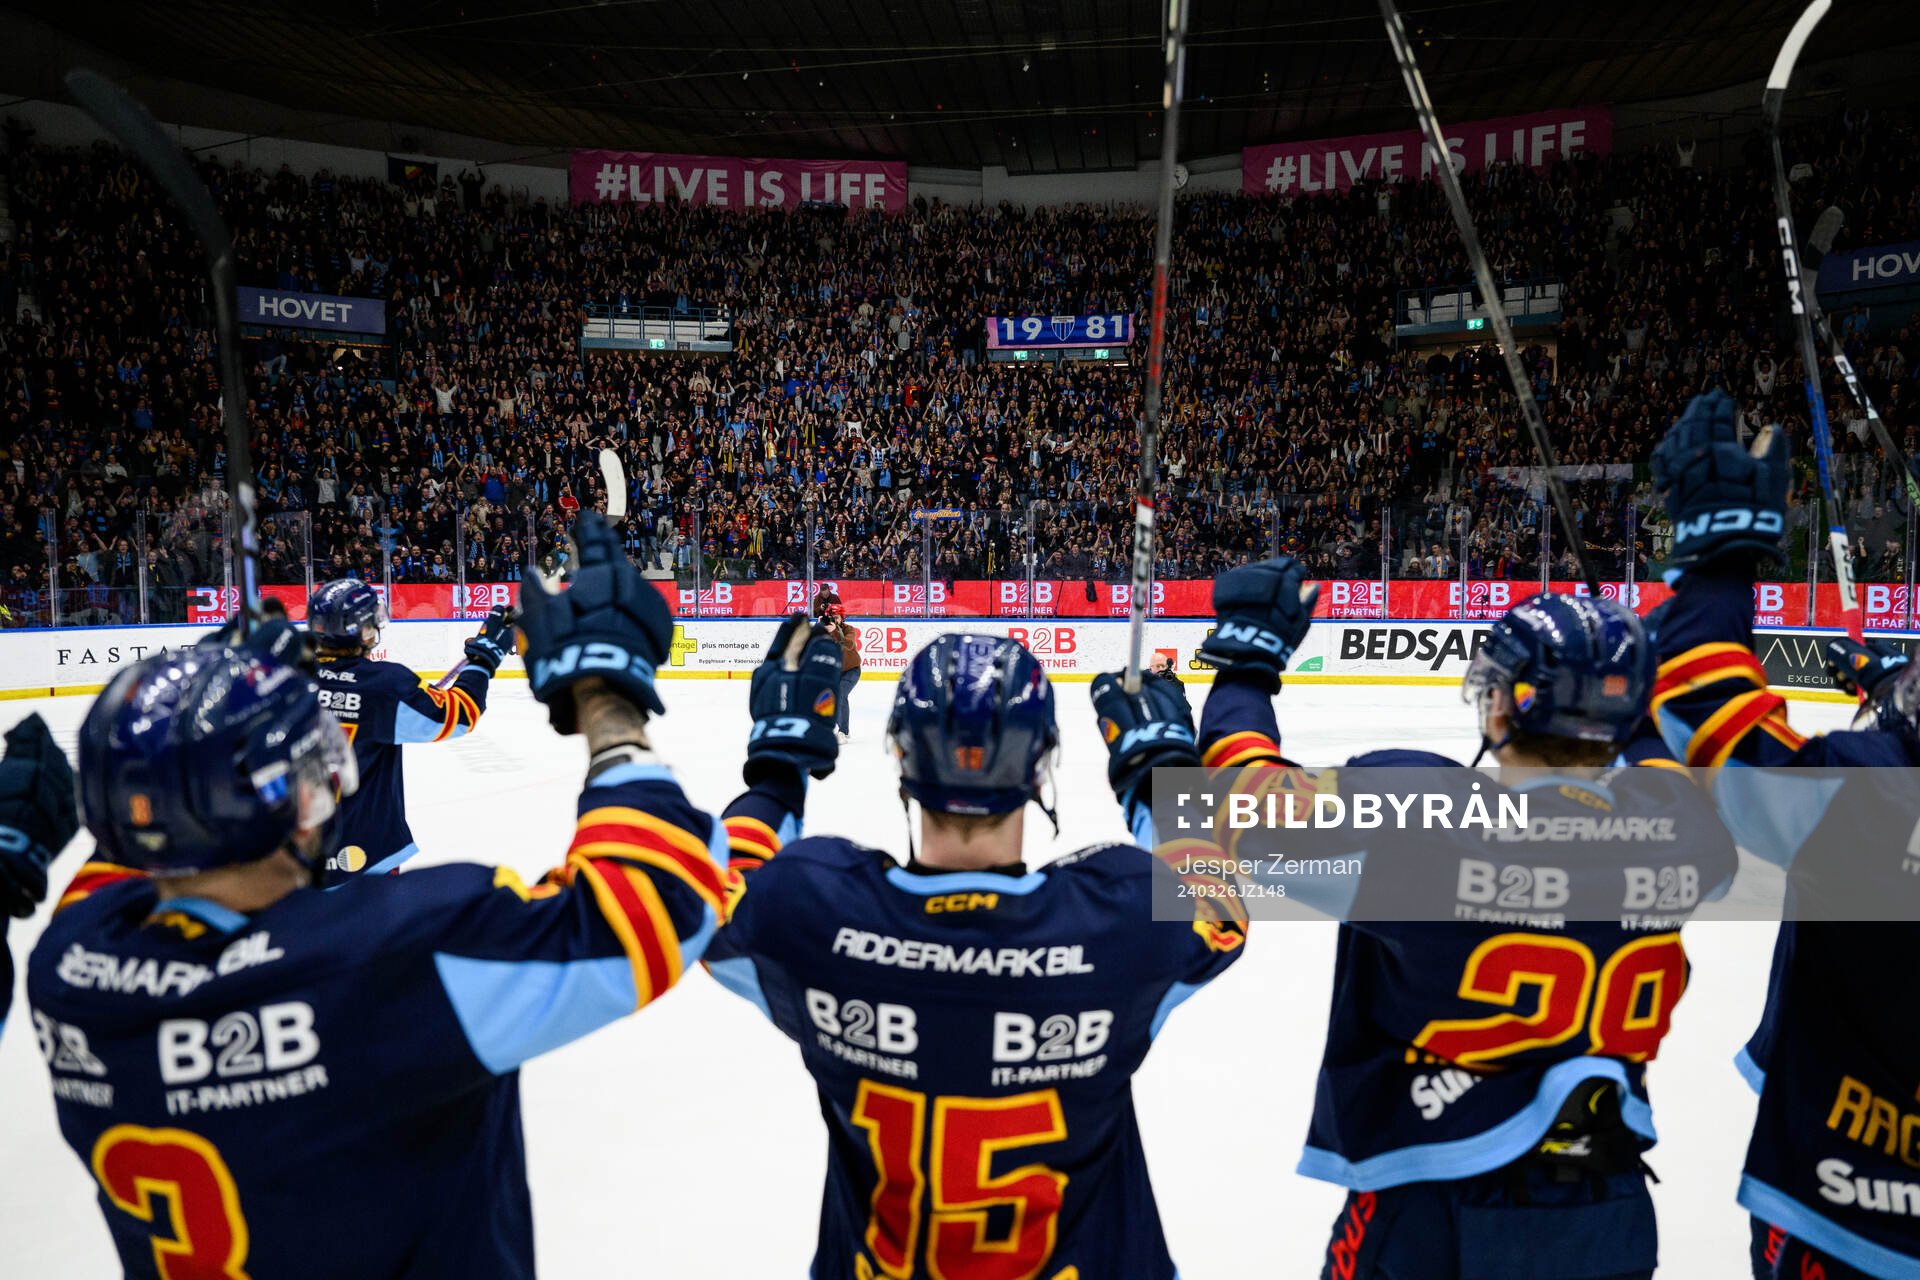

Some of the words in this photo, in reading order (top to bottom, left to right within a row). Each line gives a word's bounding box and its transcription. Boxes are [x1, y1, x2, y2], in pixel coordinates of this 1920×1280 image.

[1265, 146, 1403, 193] #LIVE
[1485, 120, 1586, 168] LIFE
[595, 163, 728, 206] #LIVE
[744, 171, 784, 207] IS
[801, 172, 885, 208] LIFE
[1777, 217, 1805, 315] CCM
[258, 296, 352, 324] HOVET
[1002, 317, 1042, 341] 19
[1086, 315, 1123, 338] 81
[1674, 508, 1784, 544] CCM
[452, 584, 510, 607] B2B
[894, 582, 945, 603] B2B
[1001, 582, 1053, 604] B2B
[1112, 582, 1165, 604] BB
[1450, 582, 1510, 606] B2B
[1867, 585, 1920, 614] B2
[718, 642, 749, 650] montage
[862, 658, 908, 667] ARTNER
[317, 689, 361, 711] B2B
[1456, 858, 1570, 909] B2B
[1622, 864, 1699, 910] B2B
[924, 893, 999, 915] CCM
[805, 987, 919, 1055] B2B
[992, 1009, 1115, 1063] B2B
[157, 1000, 321, 1085] B2B
[817, 1032, 919, 1080] IT-PARTNER
[165, 1064, 329, 1116] IT-PARTNER
[850, 1078, 1070, 1280] 15
